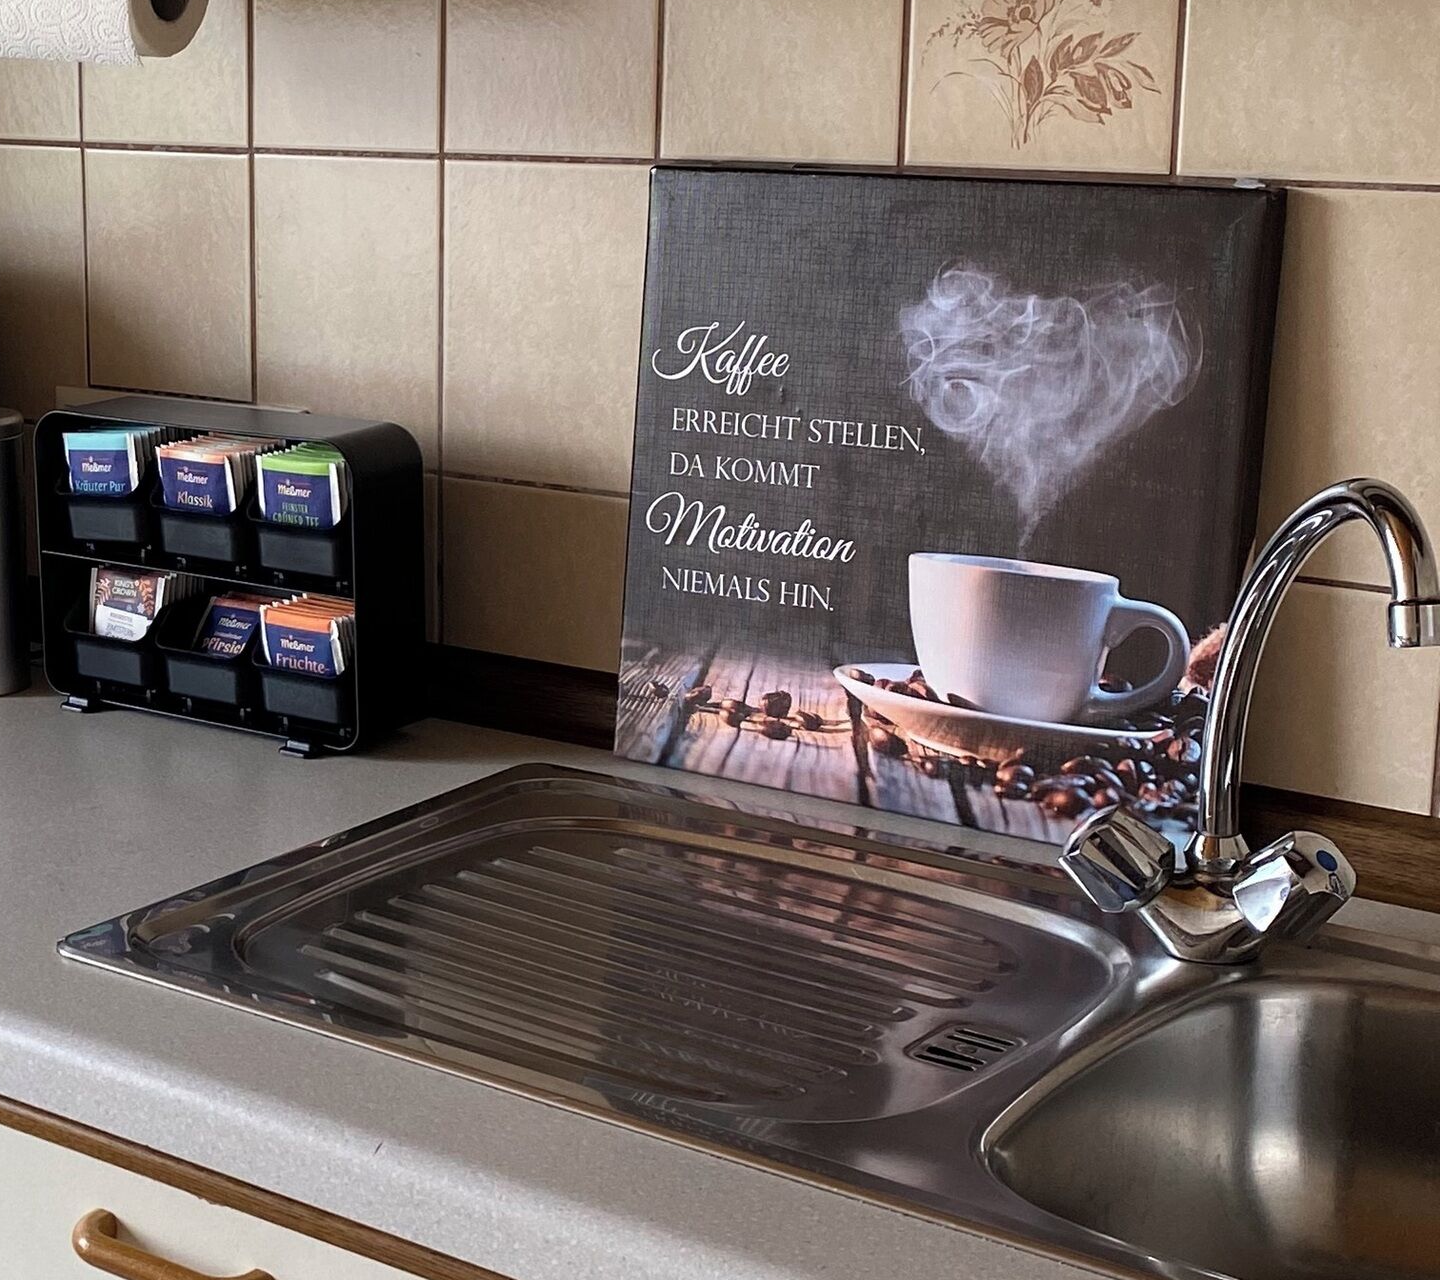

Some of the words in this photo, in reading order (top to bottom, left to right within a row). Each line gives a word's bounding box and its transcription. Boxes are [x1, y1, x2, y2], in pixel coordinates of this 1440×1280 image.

[651, 320, 790, 396] Kaffee
[671, 407, 801, 441] ERREICHT
[807, 418, 926, 456] STELLEN,
[109, 480, 126, 492] Pur
[669, 451, 705, 478] DA
[715, 455, 820, 489] KOMMT
[177, 491, 213, 509] Klassik
[645, 491, 857, 563] Motivation
[661, 566, 771, 603] NIEMALS
[778, 581, 835, 612] HIN.
